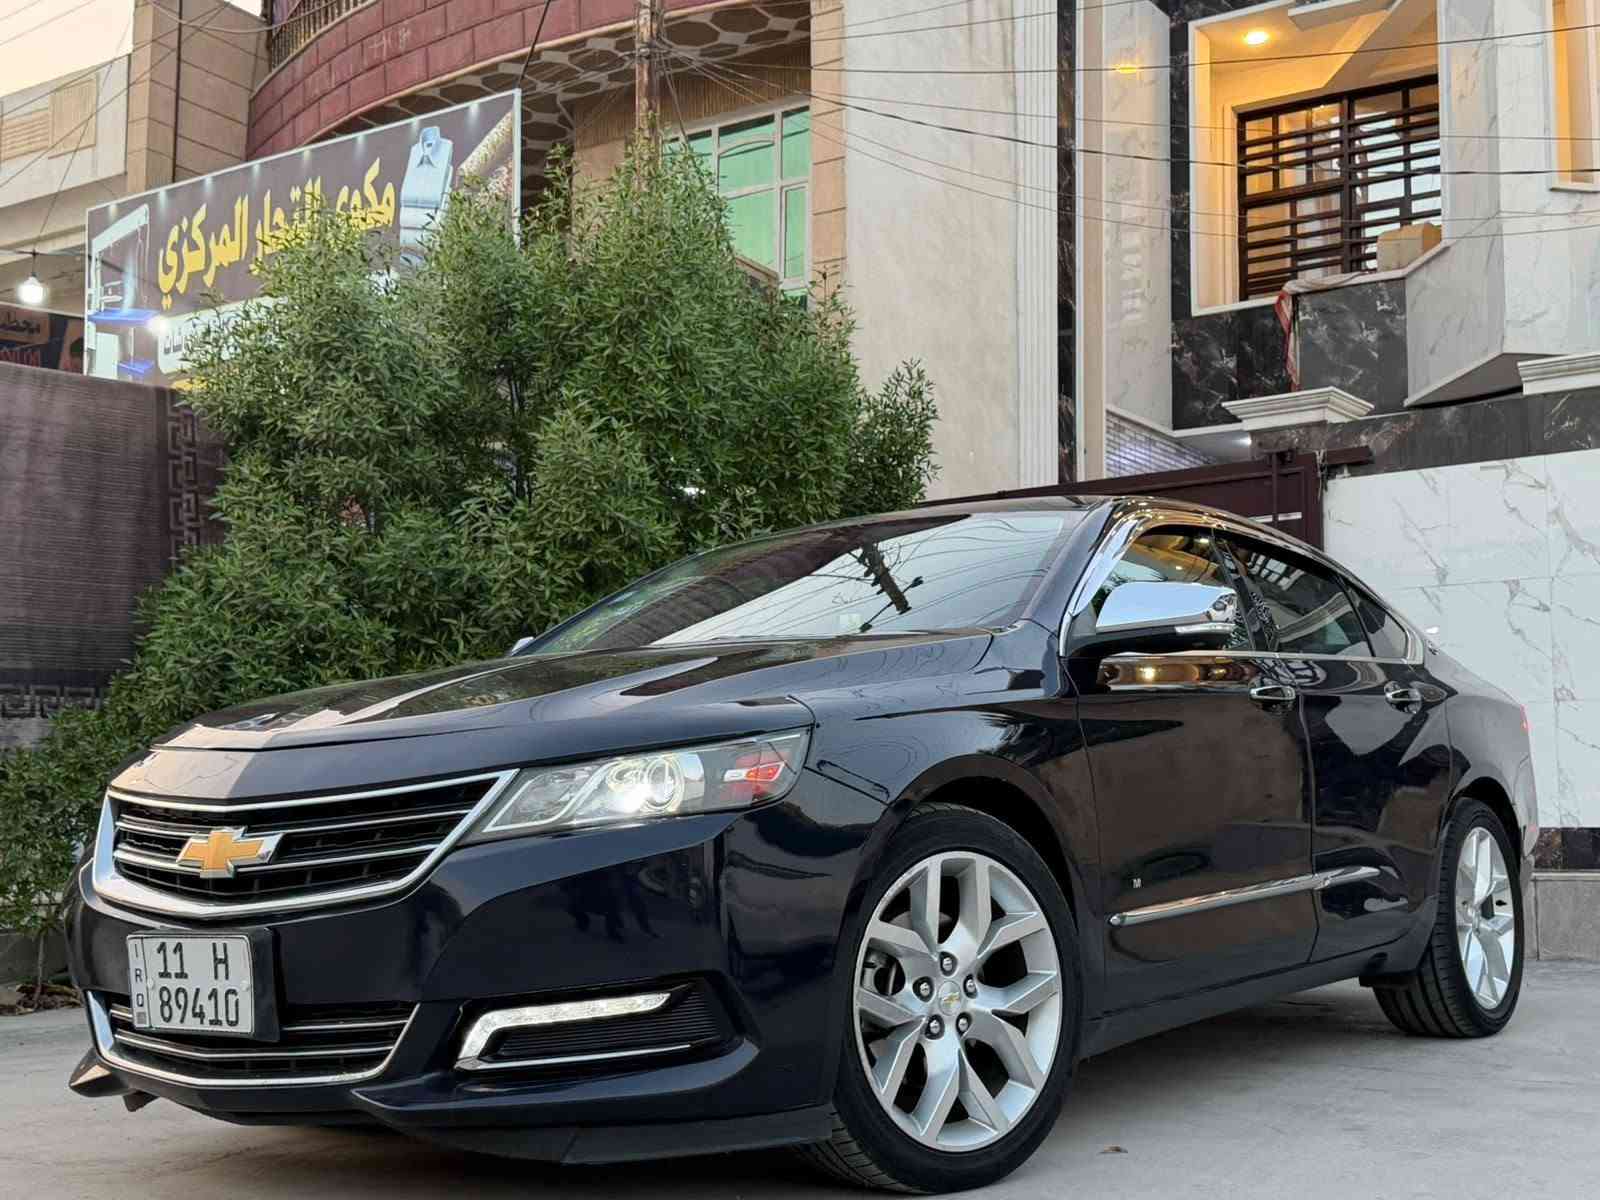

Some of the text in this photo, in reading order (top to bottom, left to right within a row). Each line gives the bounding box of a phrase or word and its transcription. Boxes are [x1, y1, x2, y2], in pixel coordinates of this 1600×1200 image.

[157, 194, 249, 311] المركزي
[156, 941, 230, 980] 11 H
[158, 985, 240, 1027] 89410
